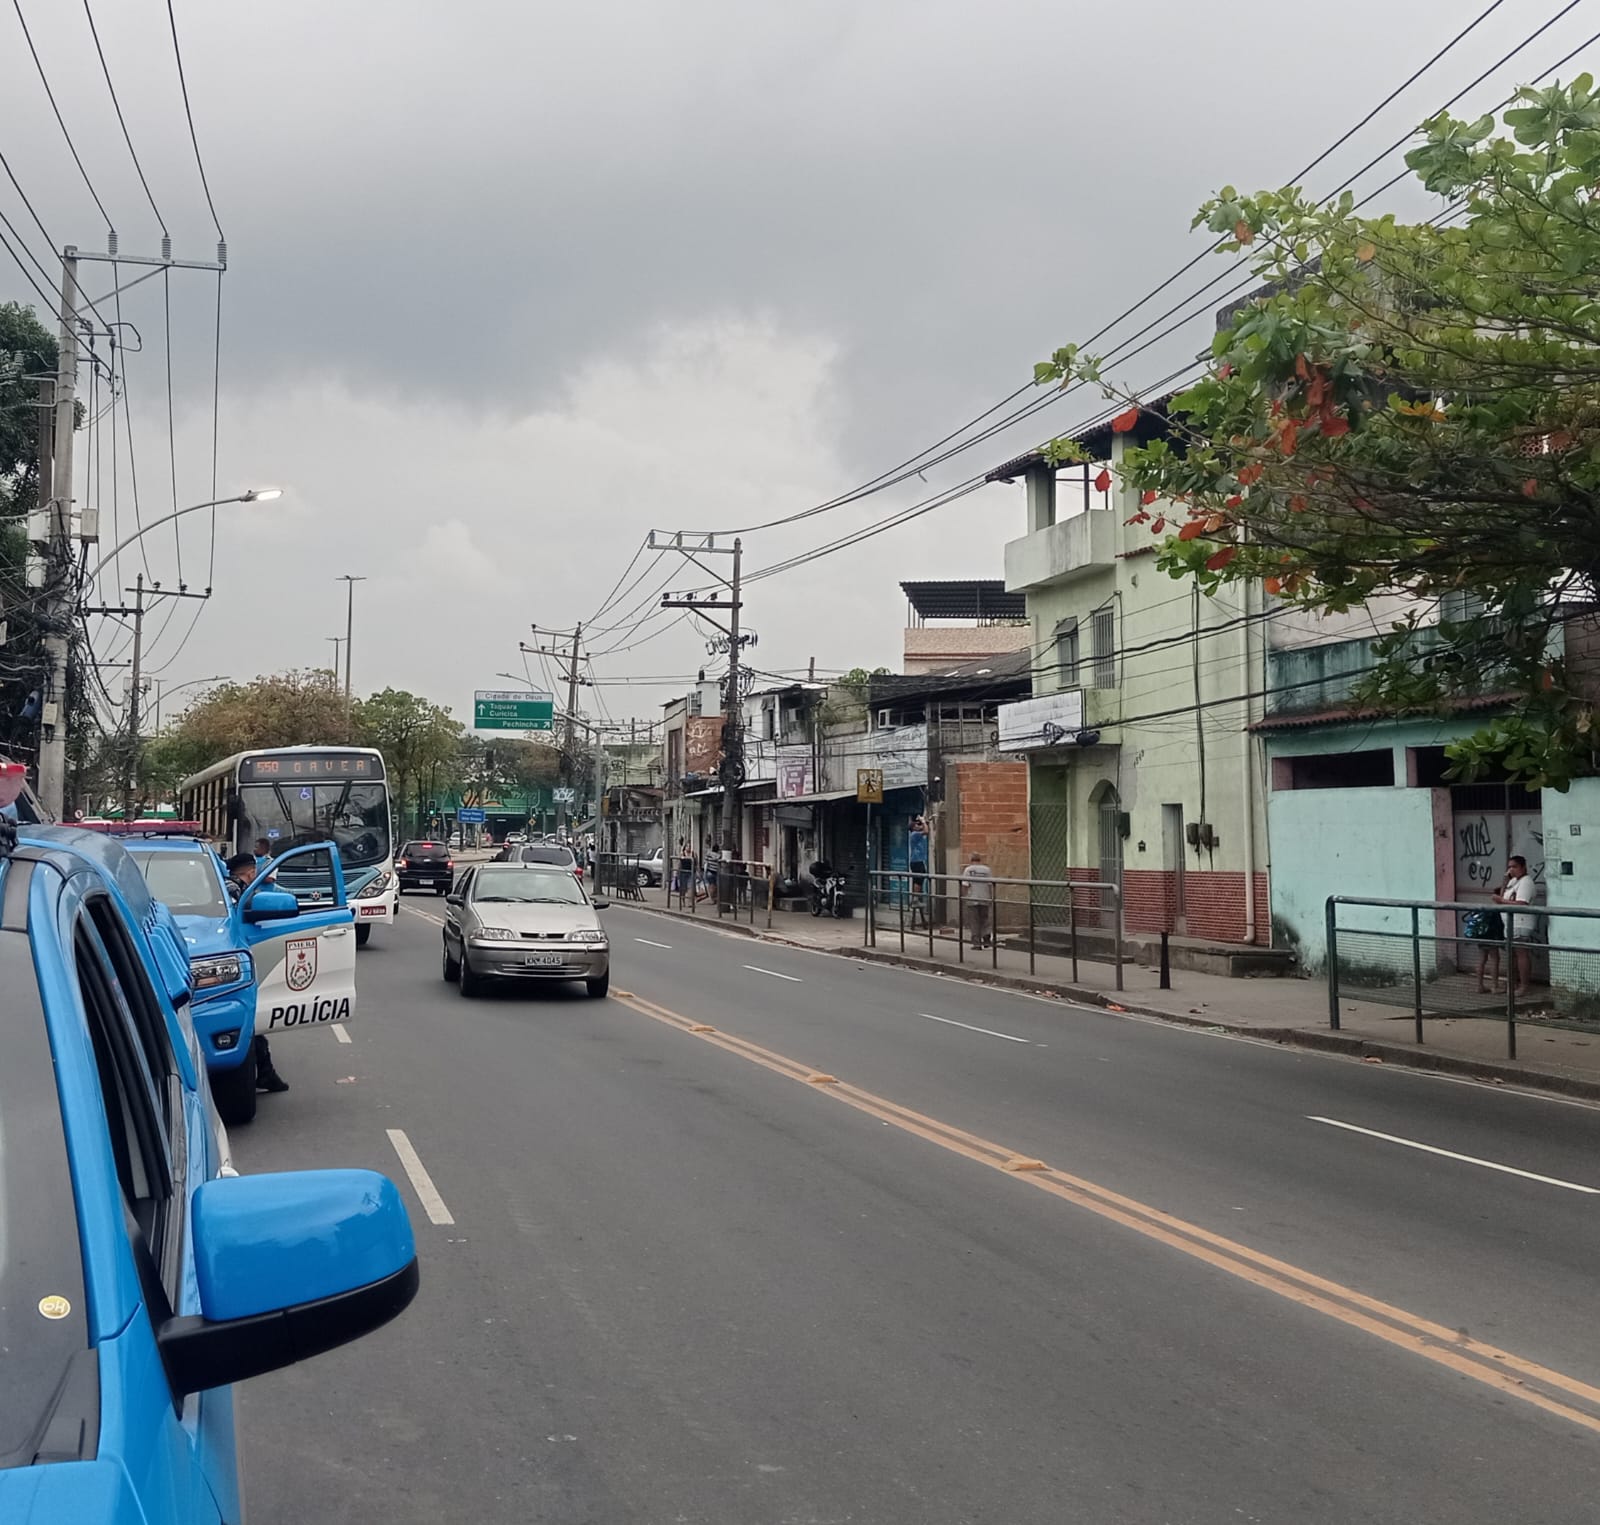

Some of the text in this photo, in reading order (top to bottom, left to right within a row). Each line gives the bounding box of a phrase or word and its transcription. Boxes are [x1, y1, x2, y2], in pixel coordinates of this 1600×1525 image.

[256, 761, 279, 773] 550
[288, 941, 315, 949] PMERJ
[269, 995, 350, 1029] POLÍCIA
